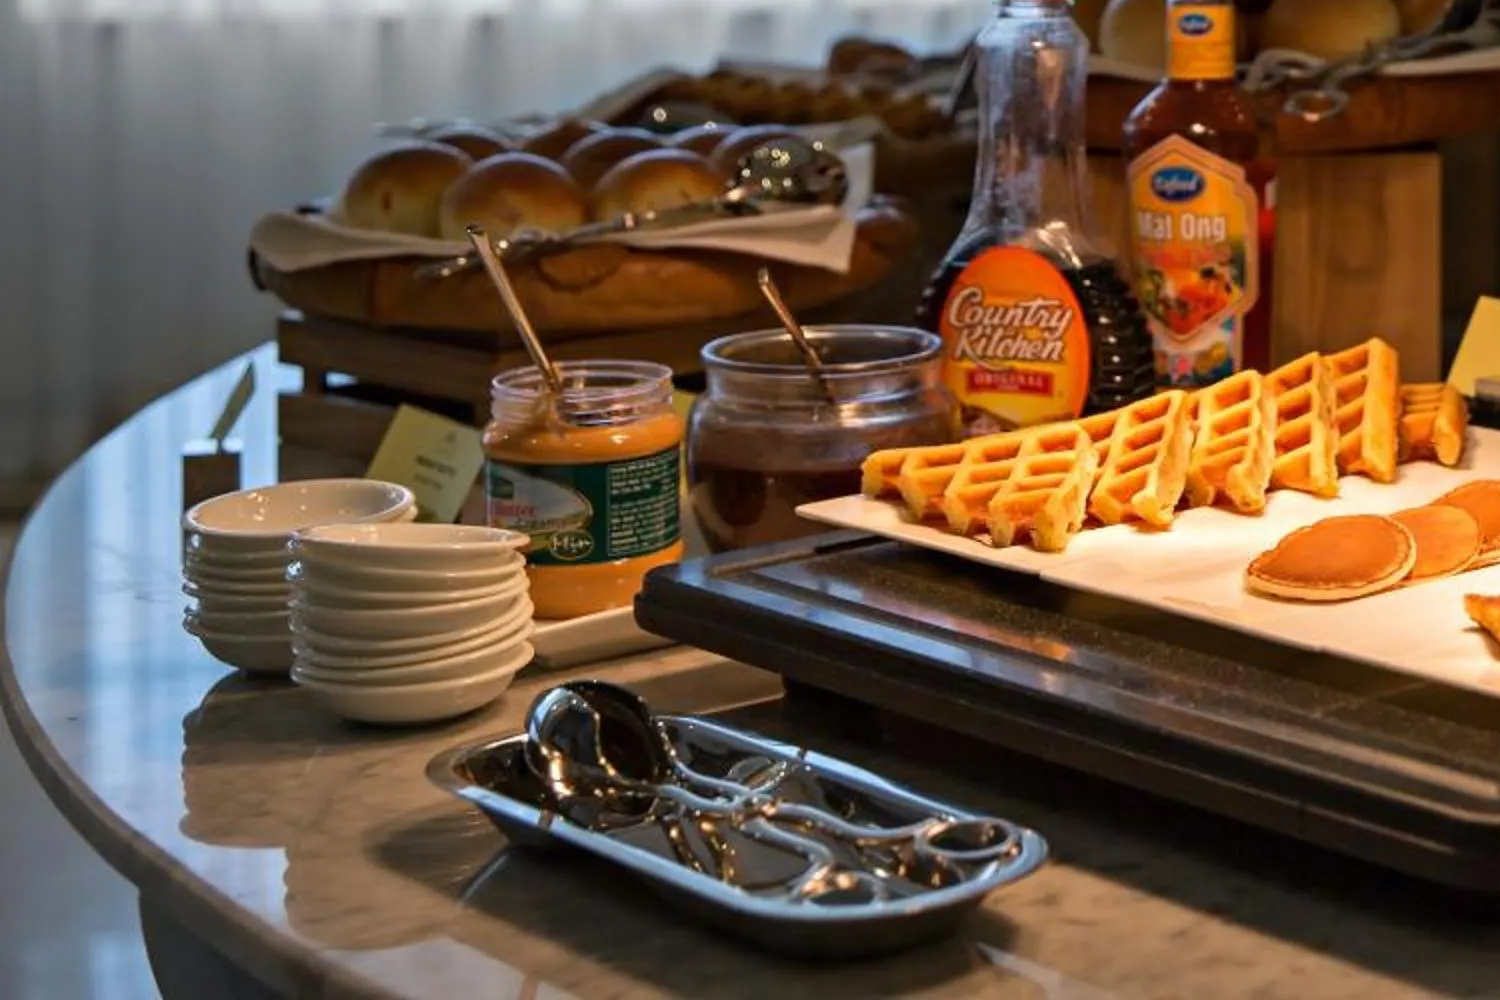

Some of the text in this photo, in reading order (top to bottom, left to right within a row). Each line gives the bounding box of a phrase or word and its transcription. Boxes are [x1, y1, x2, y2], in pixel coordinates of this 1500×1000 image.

[1181, 213, 1226, 243] Ong
[949, 286, 1073, 341] Country
[954, 325, 1064, 371] Kitchen
